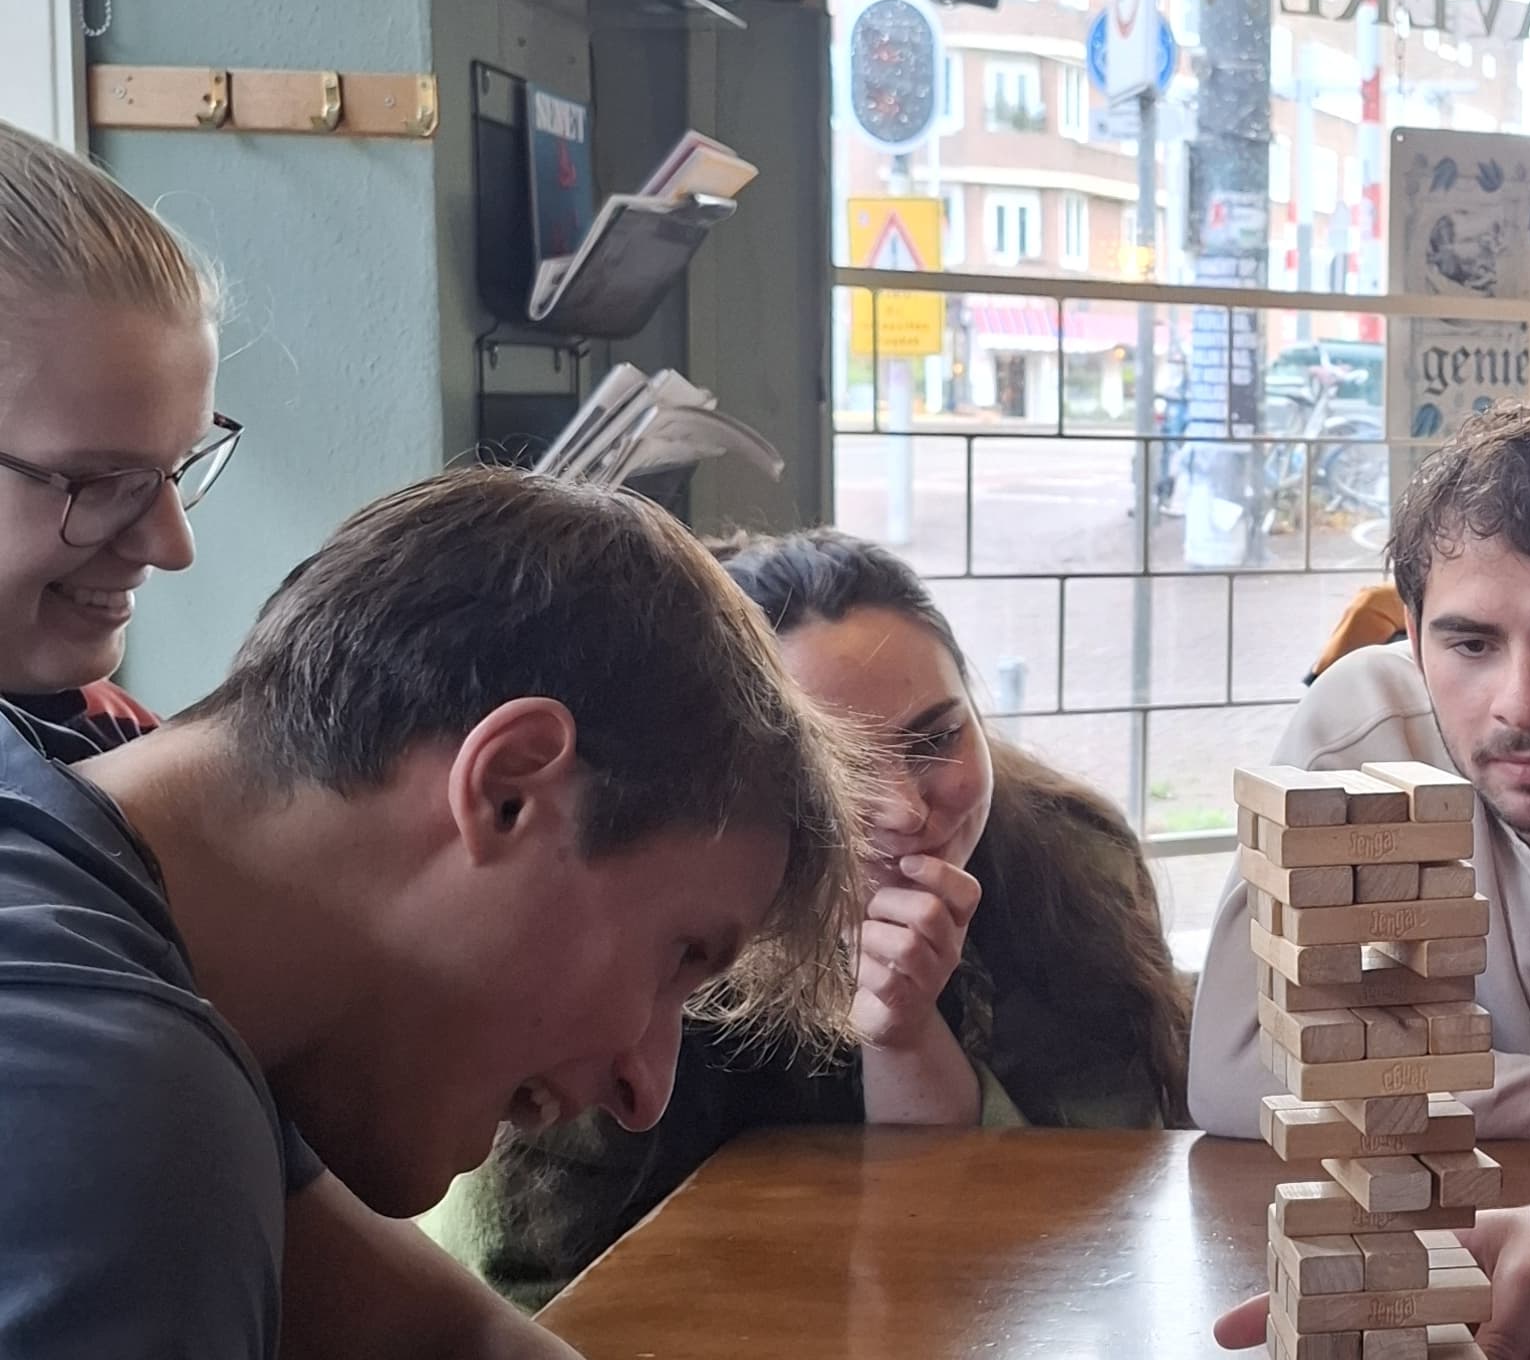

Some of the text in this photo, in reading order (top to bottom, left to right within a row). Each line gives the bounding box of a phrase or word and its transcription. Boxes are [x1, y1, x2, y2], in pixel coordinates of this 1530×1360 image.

[1349, 830, 1397, 859] Jenga
[1369, 906, 1418, 938] Jenga
[1367, 1296, 1416, 1328] Jenga
